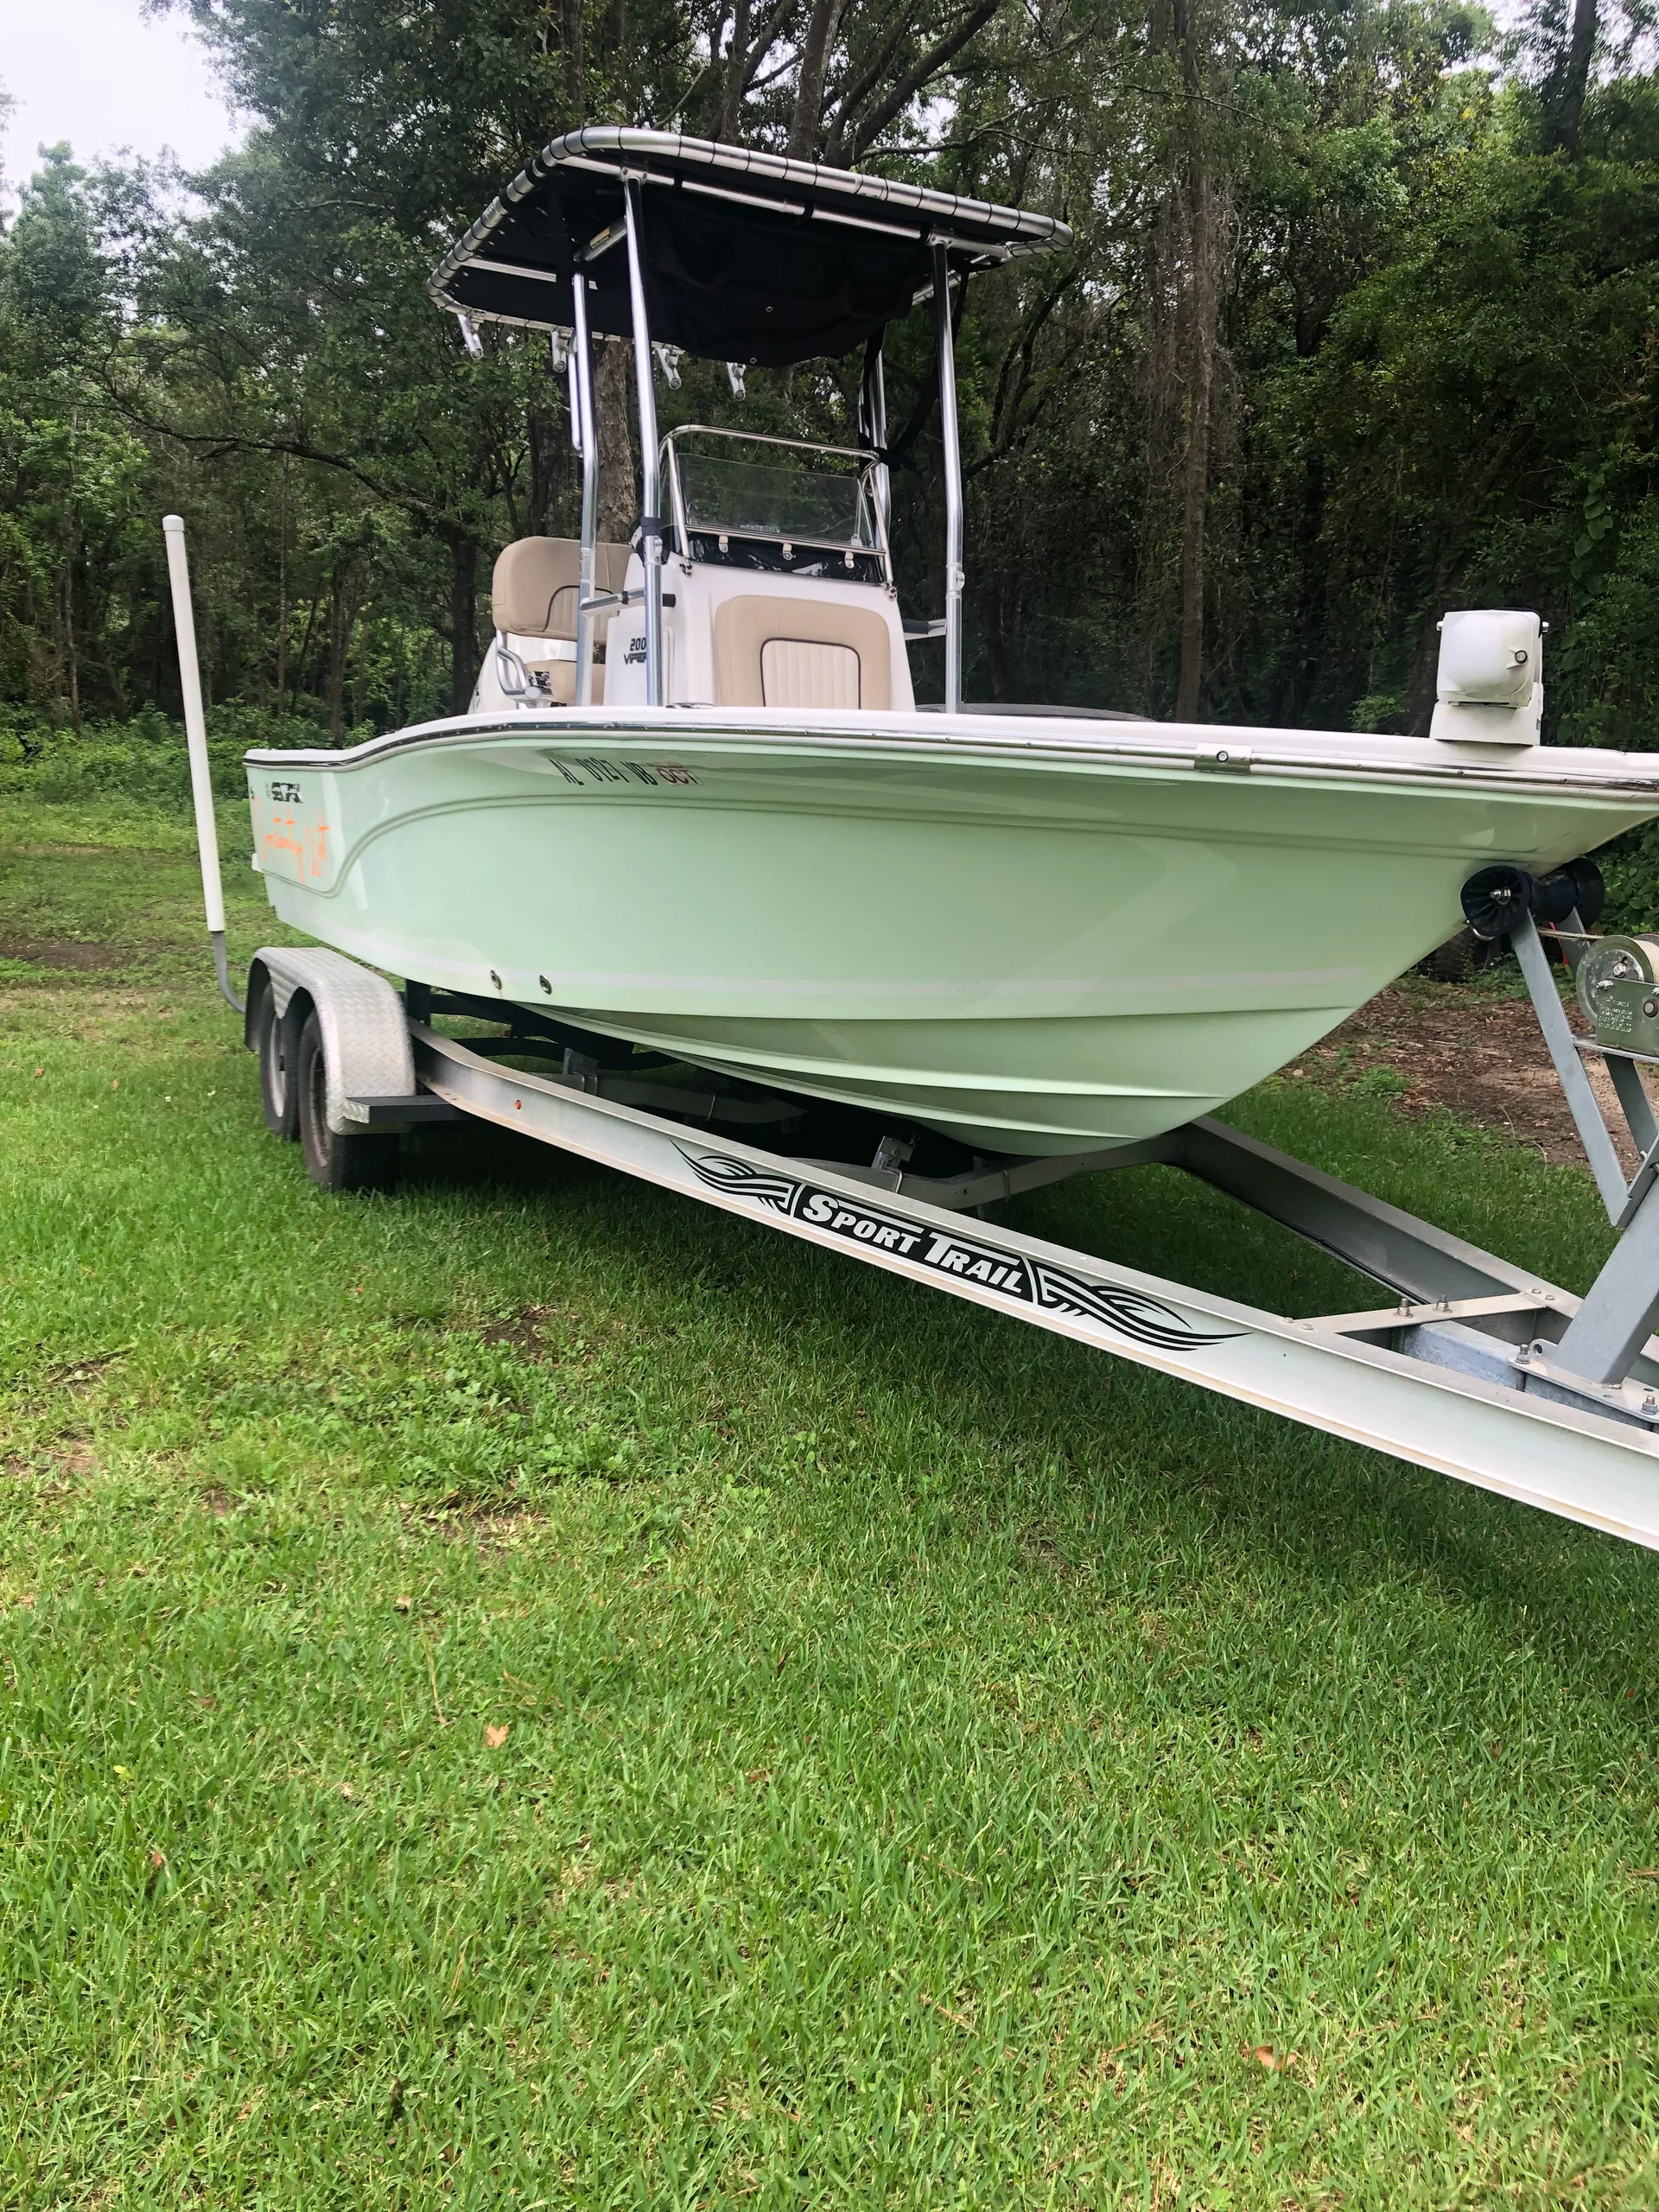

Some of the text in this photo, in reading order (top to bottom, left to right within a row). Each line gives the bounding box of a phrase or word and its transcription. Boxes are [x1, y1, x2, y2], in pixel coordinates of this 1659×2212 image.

[629, 637, 647, 652] 200
[549, 759, 585, 785] AL
[656, 767, 699, 785] OCT
[802, 1193, 1024, 1294] SPORT TRAIL
